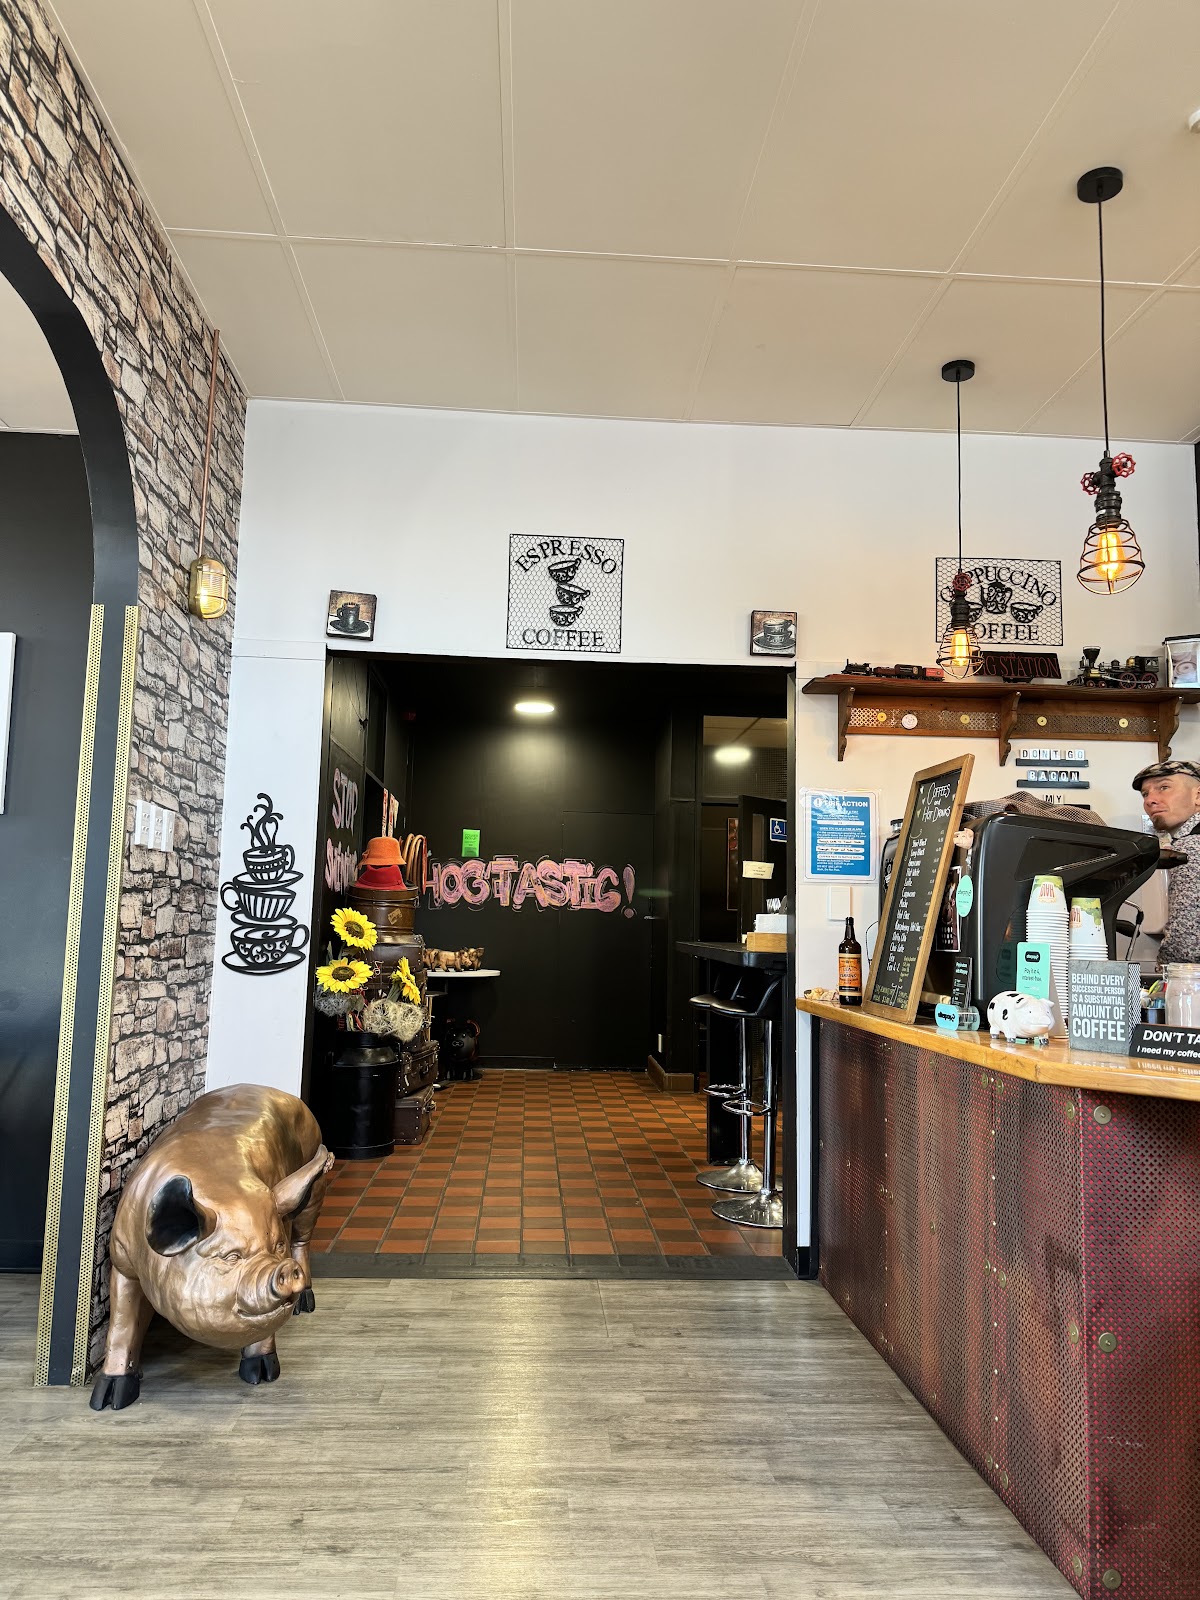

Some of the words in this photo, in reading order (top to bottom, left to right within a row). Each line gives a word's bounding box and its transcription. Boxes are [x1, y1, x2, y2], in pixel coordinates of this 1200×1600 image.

[515, 539, 617, 573] ESPRESSO
[941, 566, 1057, 606] CPPUCCINO
[522, 628, 605, 647] COFFEE
[972, 623, 1039, 641] OFFEE
[1000, 655, 1060, 678] STATION
[1022, 750, 1058, 758] DONT
[1067, 750, 1083, 759] GO
[1030, 771, 1078, 780] BACON
[332, 767, 359, 837] STOP
[1045, 794, 1062, 803] MY
[1072, 974, 1098, 985] BEHIND
[1101, 975, 1125, 986] EVERY
[1072, 985, 1103, 994] SUCCESSFUL
[1104, 986, 1125, 995] PERSON
[1072, 994, 1078, 1002] IS
[1079, 994, 1084, 1002] A
[1084, 995, 1125, 1006] SUBSTANTIAL
[1072, 1004, 1111, 1020] AMOUNT
[1113, 1006, 1126, 1020] OF
[1072, 1018, 1126, 1042] COFFEE
[1143, 1030, 1184, 1043] DON'T
[1163, 1049, 1176, 1057] my
